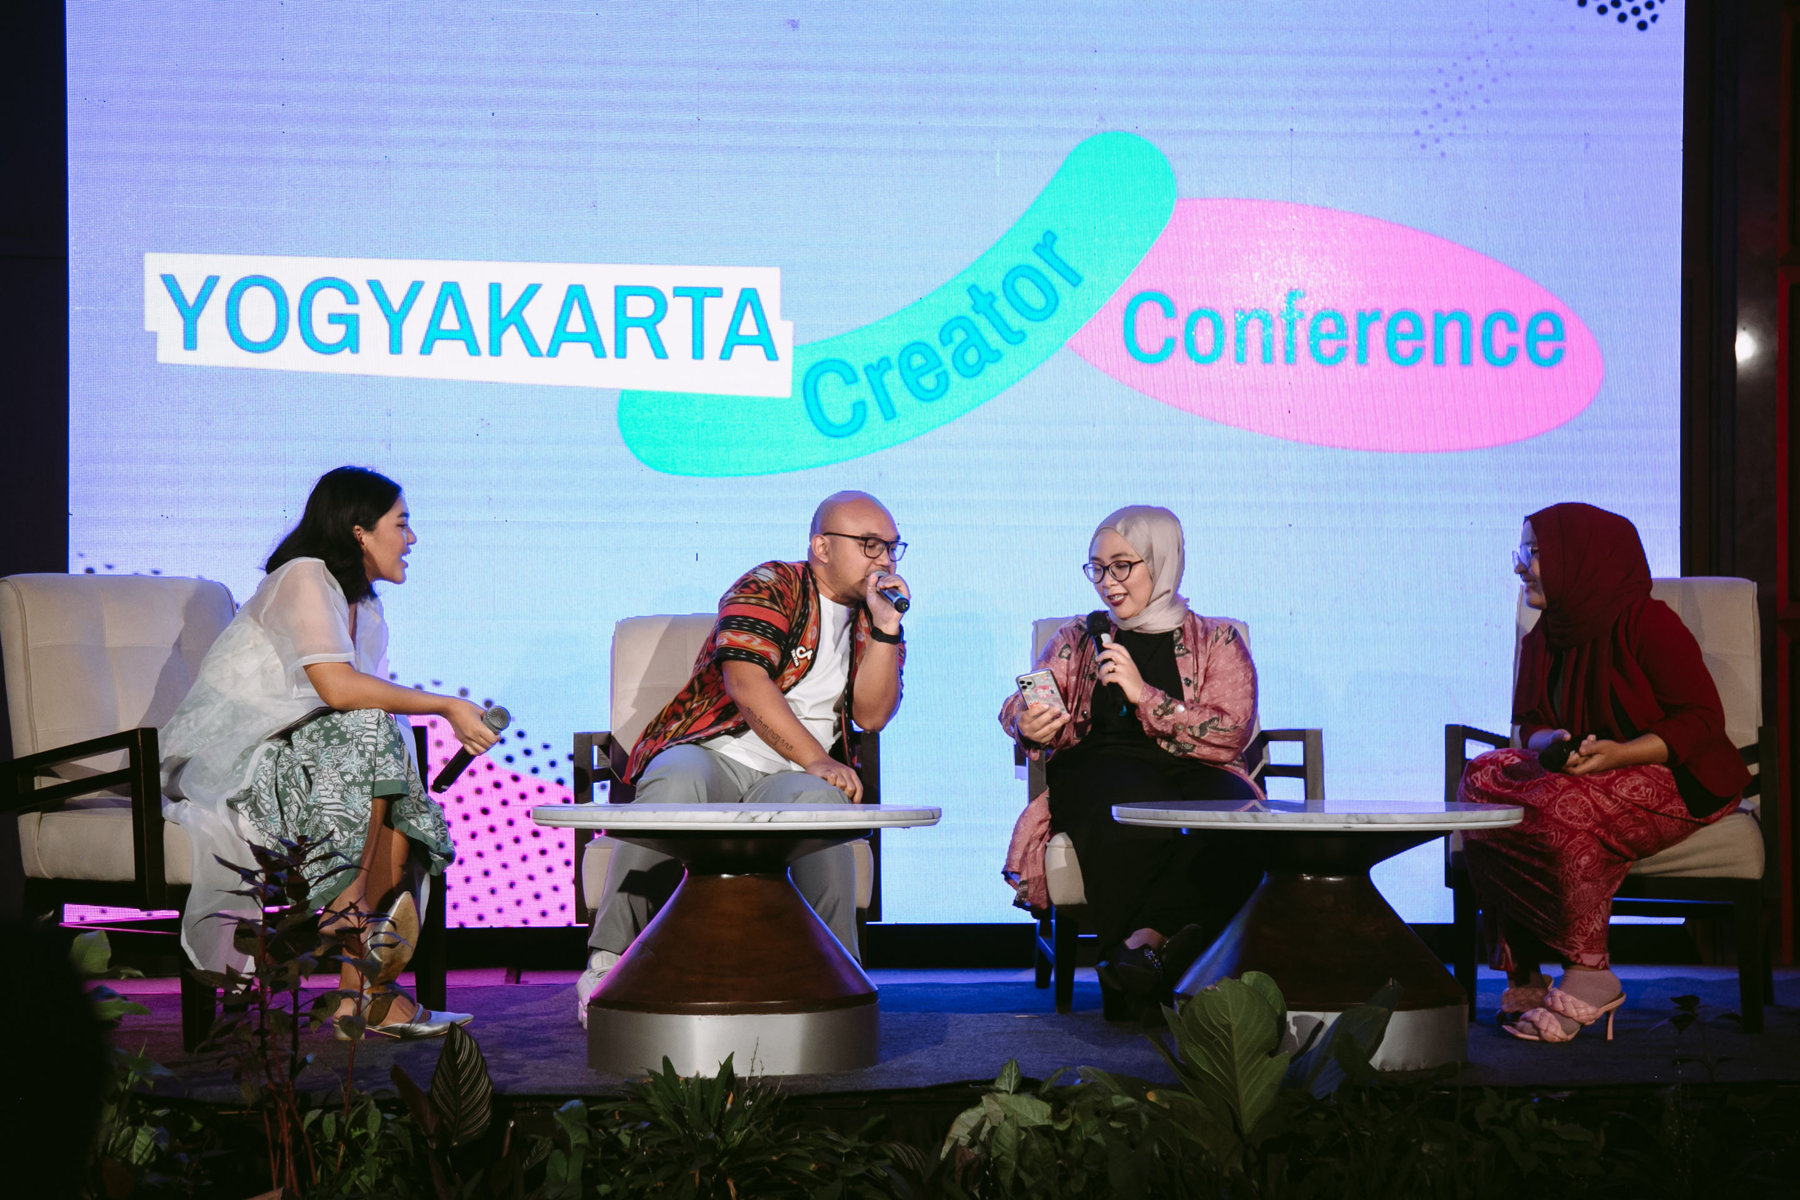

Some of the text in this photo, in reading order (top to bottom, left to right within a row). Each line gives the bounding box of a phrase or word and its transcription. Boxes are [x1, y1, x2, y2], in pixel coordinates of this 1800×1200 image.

[160, 231, 1565, 438] YOGYAKARTA Creator Conference
